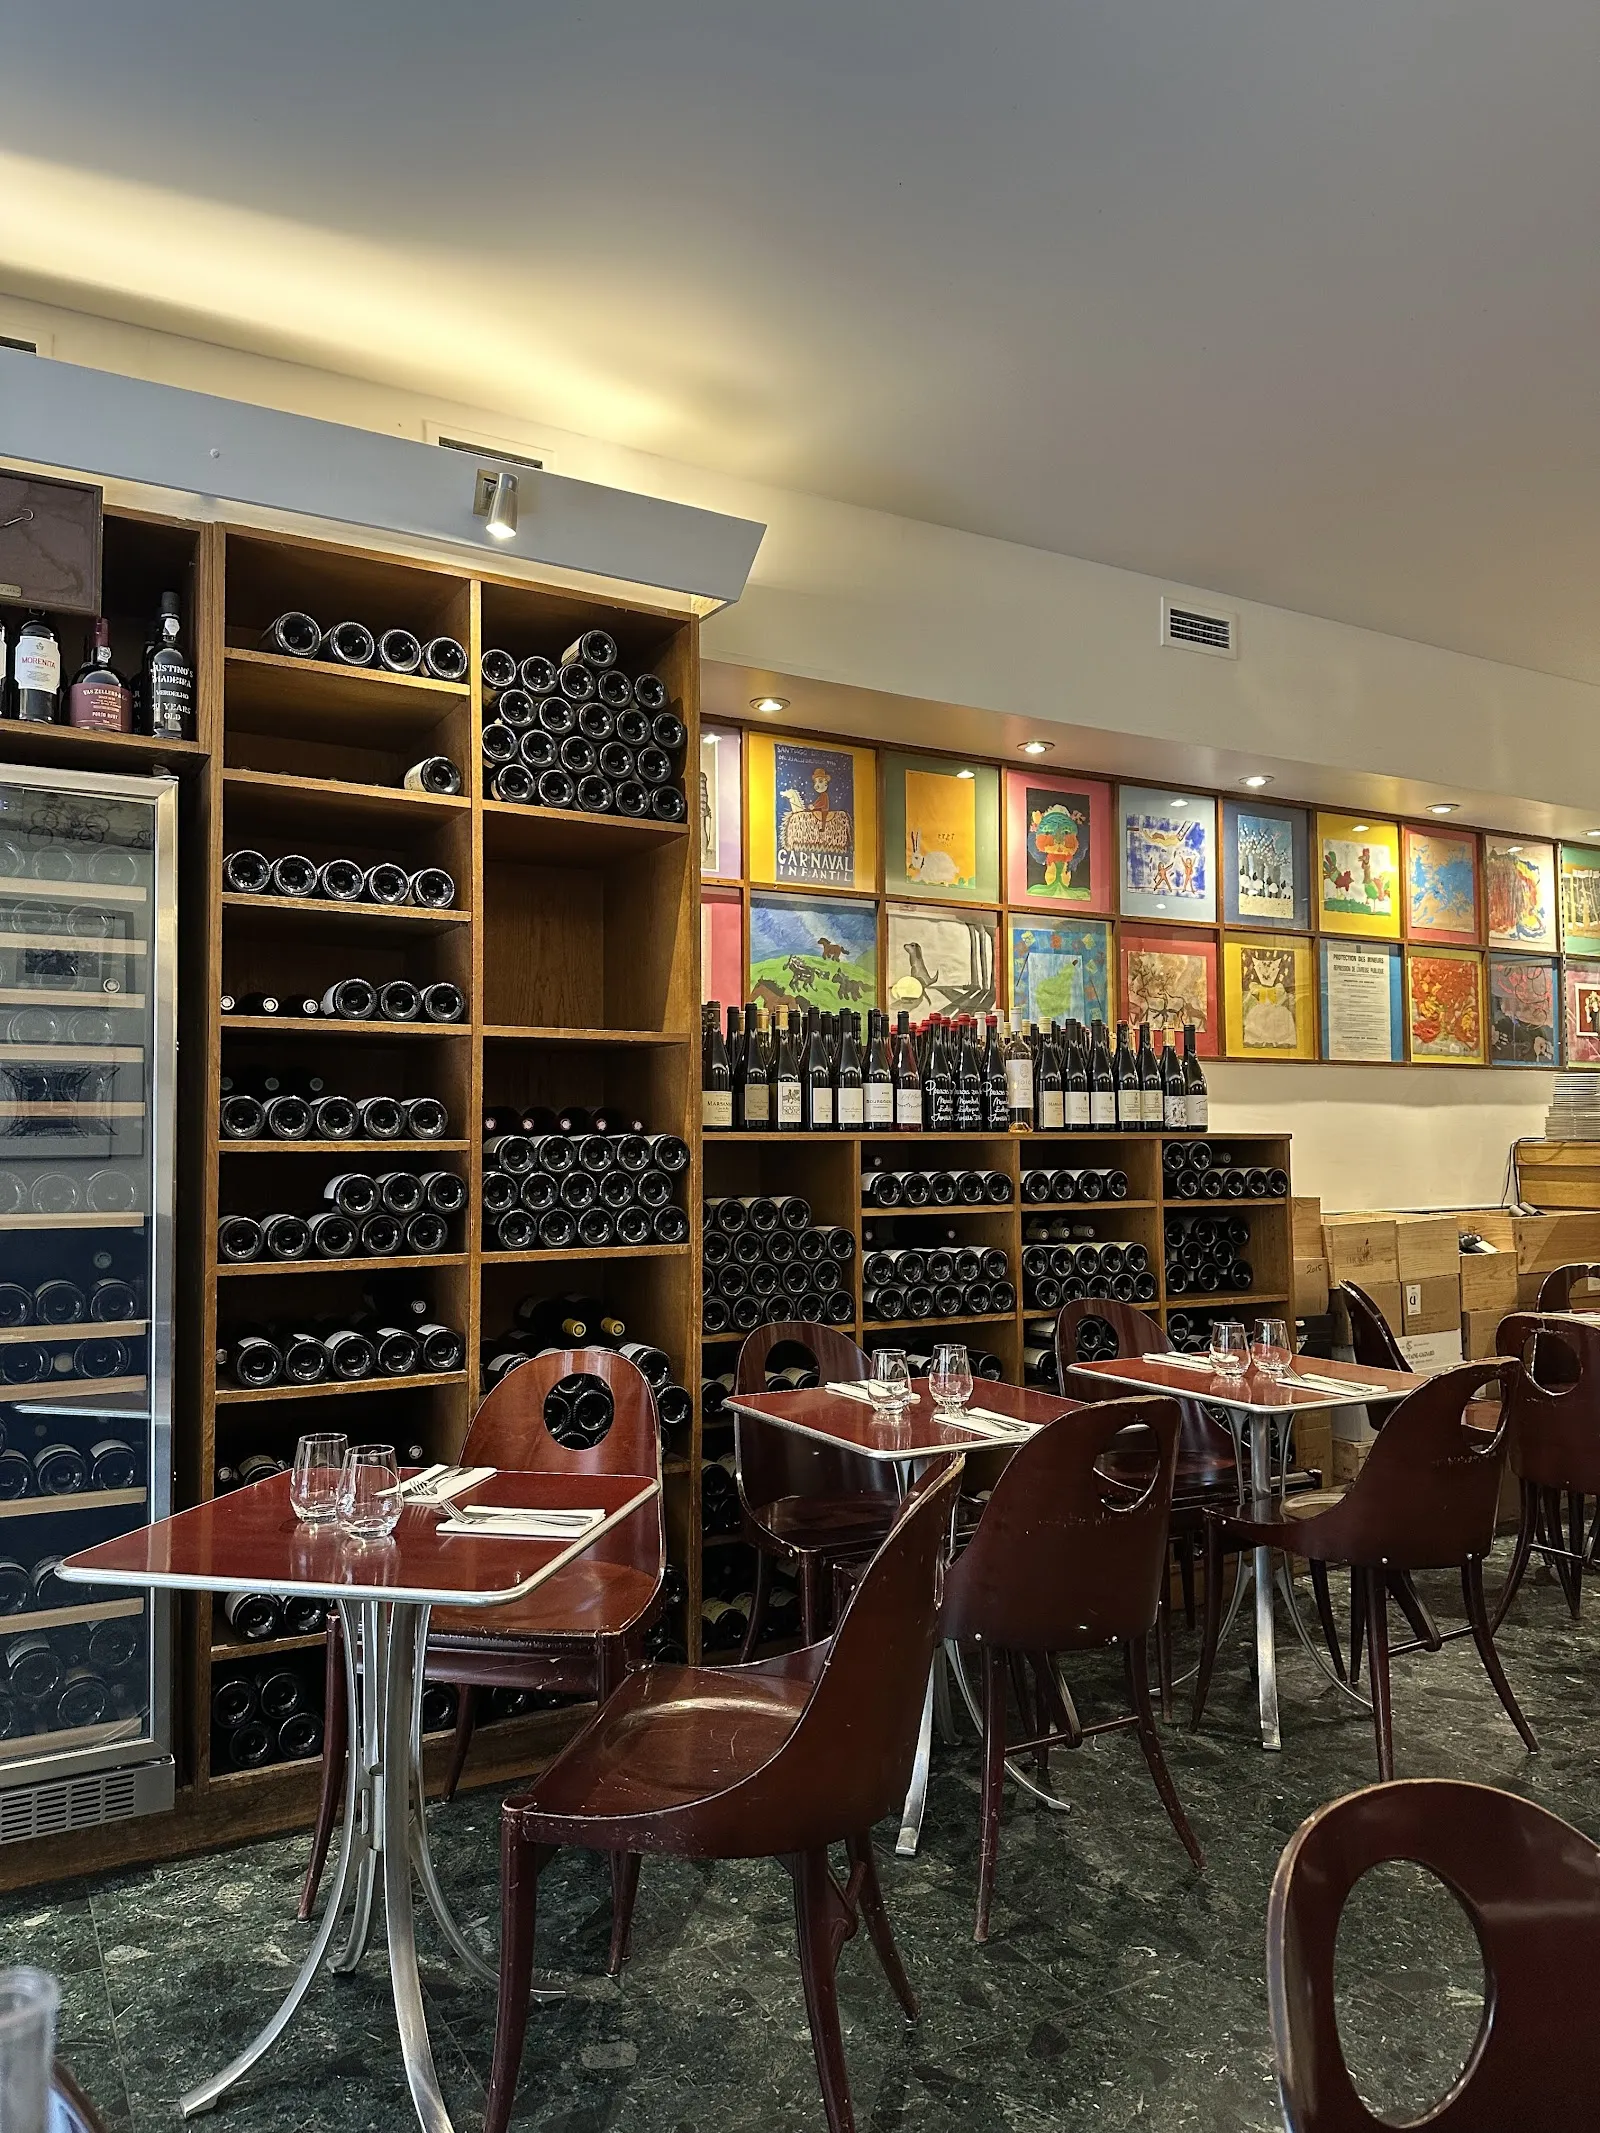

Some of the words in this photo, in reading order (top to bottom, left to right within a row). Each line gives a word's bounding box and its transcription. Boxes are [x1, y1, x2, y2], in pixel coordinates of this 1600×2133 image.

[21, 656, 56, 669] MORENITA
[152, 675, 191, 688] MADEIRA
[156, 689, 189, 700] VERDELHO
[163, 702, 191, 714] YEARS
[163, 712, 181, 720] OLD
[777, 849, 854, 873] CARNAVAL
[778, 867, 852, 882] INFANTIL
